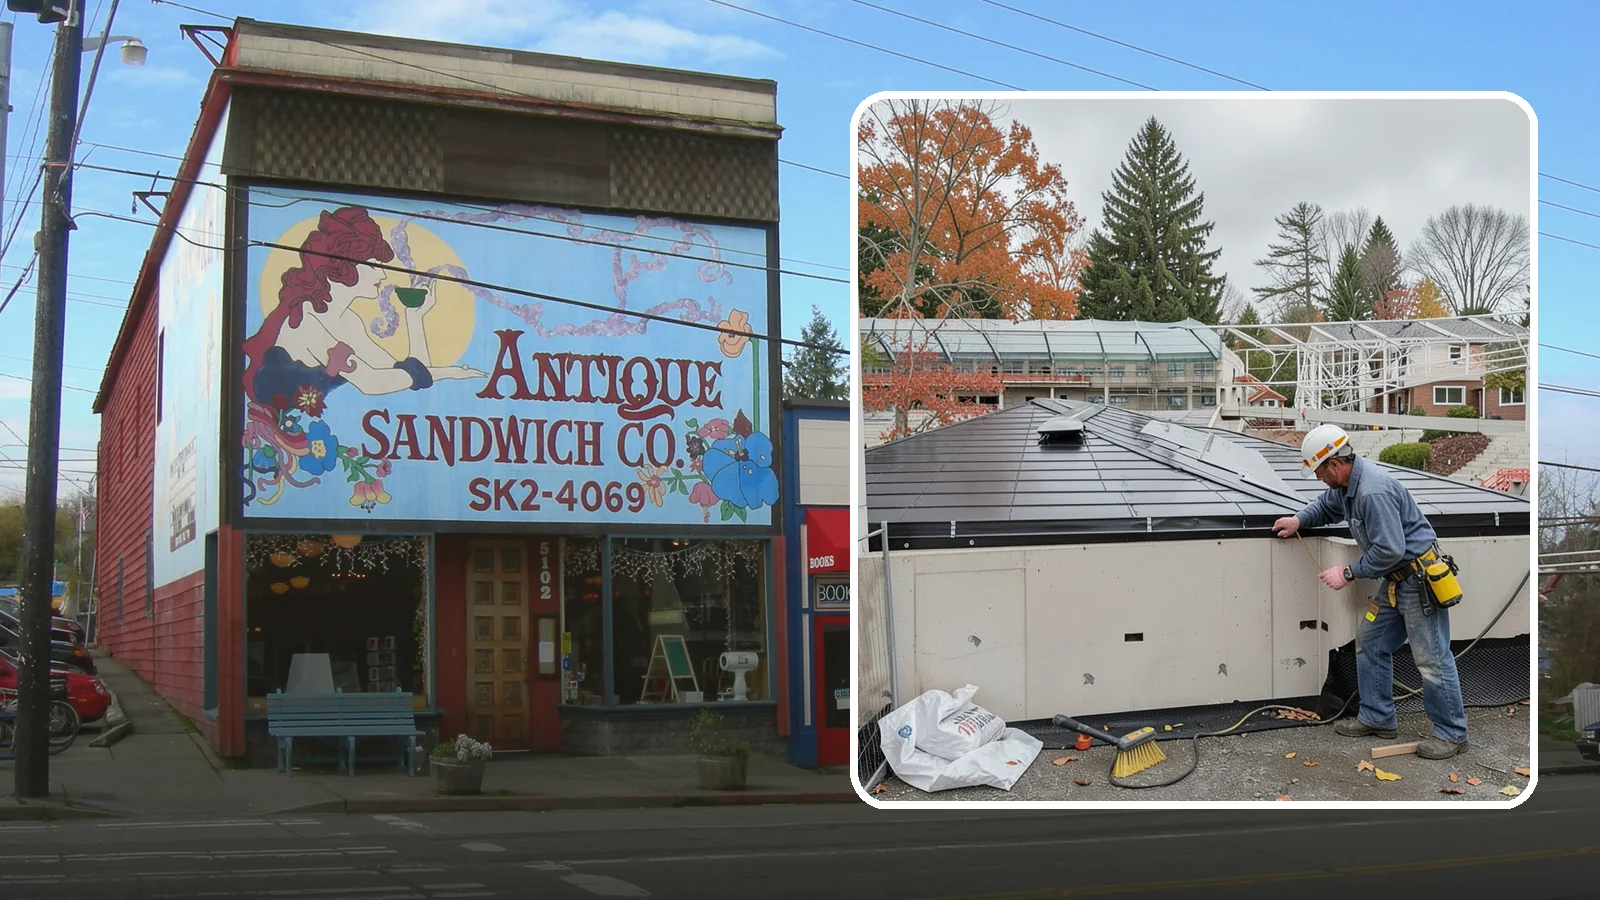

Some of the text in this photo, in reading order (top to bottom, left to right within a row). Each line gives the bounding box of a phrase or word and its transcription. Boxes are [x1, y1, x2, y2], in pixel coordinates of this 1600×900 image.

[475, 329, 723, 420] ANTIQUE
[361, 408, 685, 468] SANDWICH CO.
[468, 477, 645, 513] SK2-4069
[540, 541, 551, 599] 5102
[809, 555, 835, 569] BOOKS
